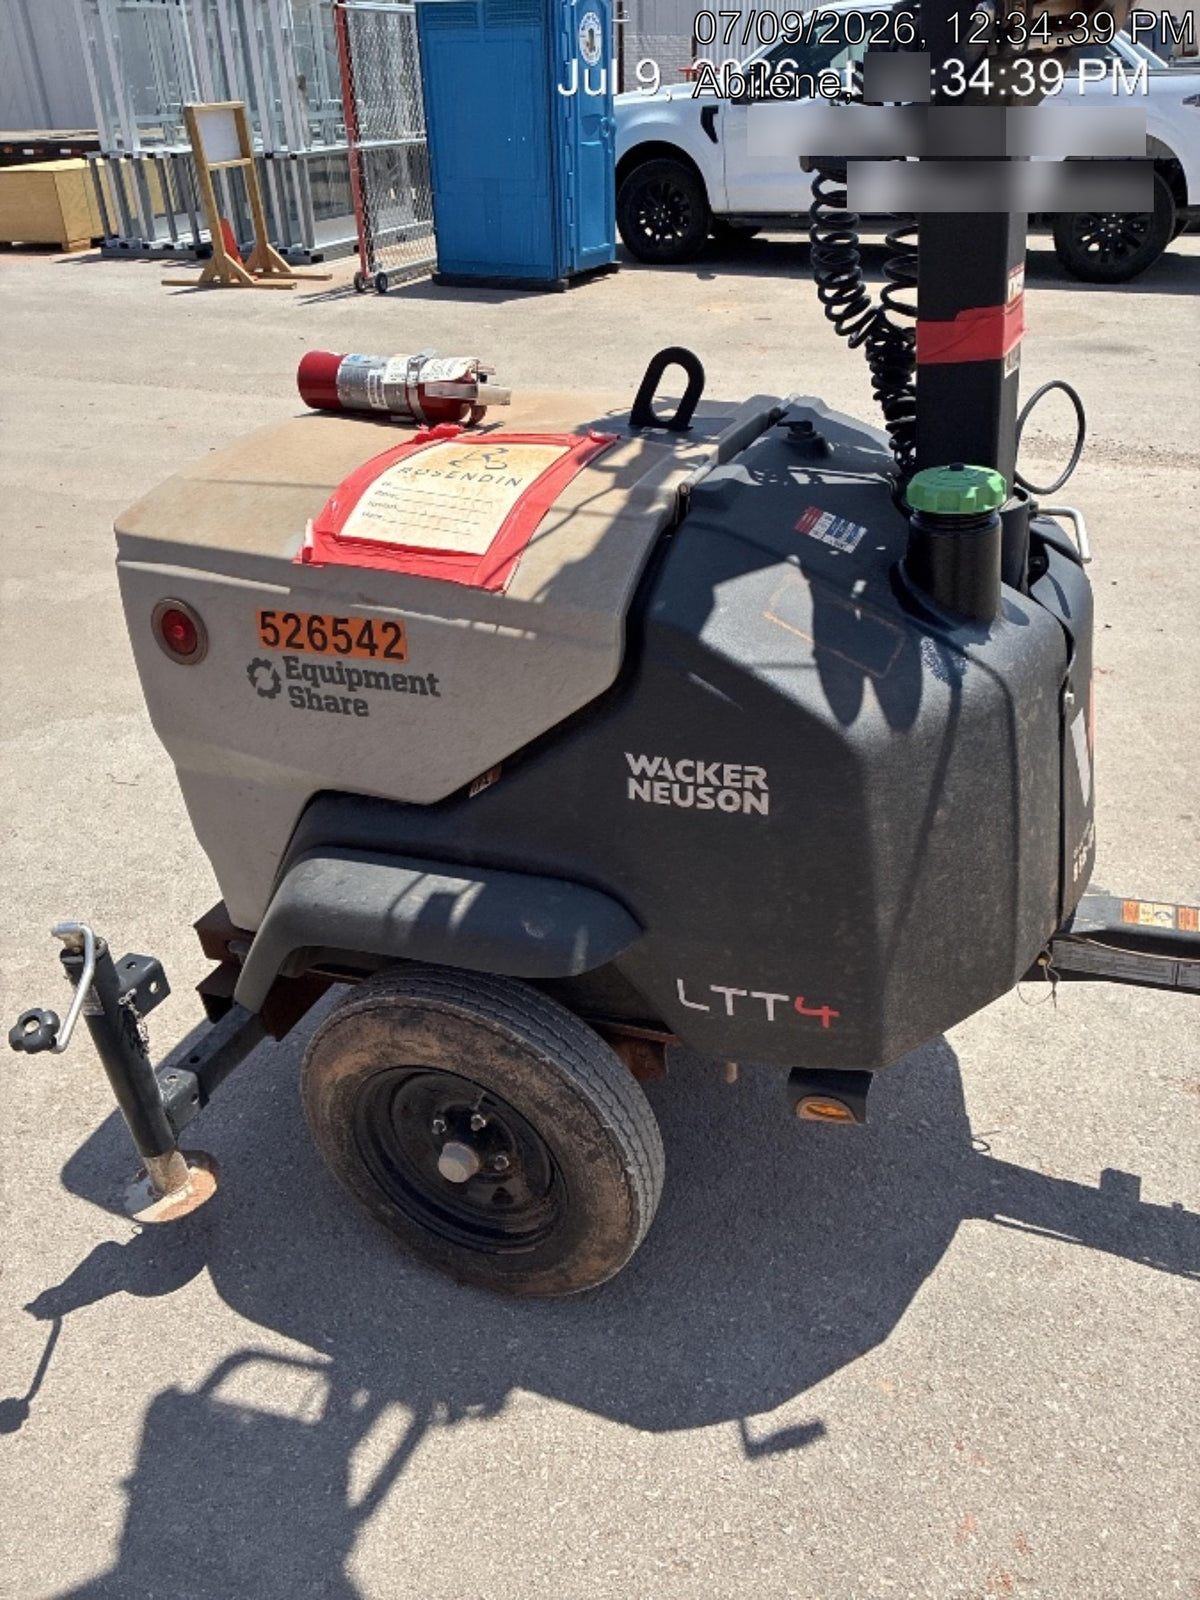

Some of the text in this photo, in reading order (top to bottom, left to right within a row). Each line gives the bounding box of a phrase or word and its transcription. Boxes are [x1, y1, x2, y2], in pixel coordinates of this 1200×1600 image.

[398, 467, 523, 487] ROSENDIN
[259, 611, 404, 660] 526542
[282, 655, 441, 697] Equipment
[287, 685, 369, 717] Share
[624, 752, 769, 790] WACKER
[627, 777, 769, 816] NEUSON
[676, 978, 840, 1029] LTT4
